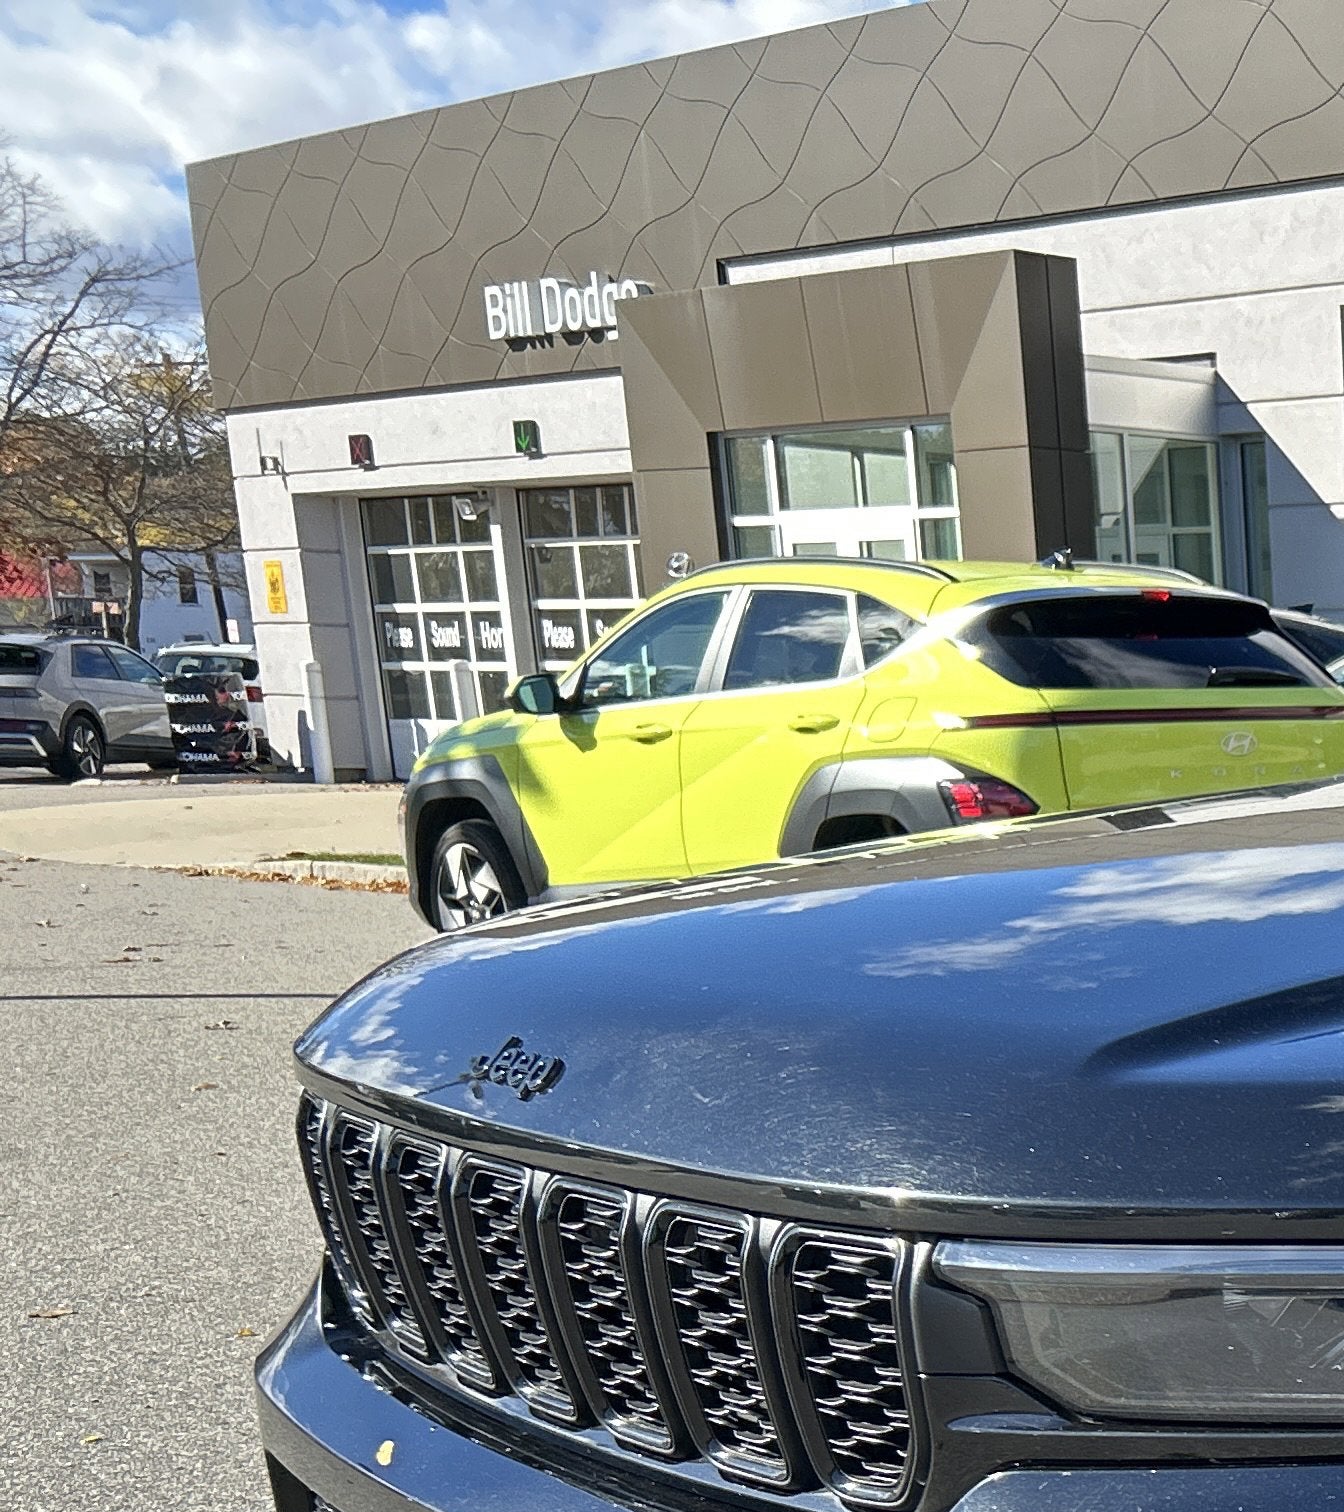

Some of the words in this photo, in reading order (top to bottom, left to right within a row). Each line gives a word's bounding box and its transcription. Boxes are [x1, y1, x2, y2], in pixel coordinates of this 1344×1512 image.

[484, 281, 532, 340] Bill
[385, 621, 413, 648] Please
[431, 621, 461, 648] Sound
[542, 619, 575, 649] Please
[472, 1035, 566, 1102] Jeep
